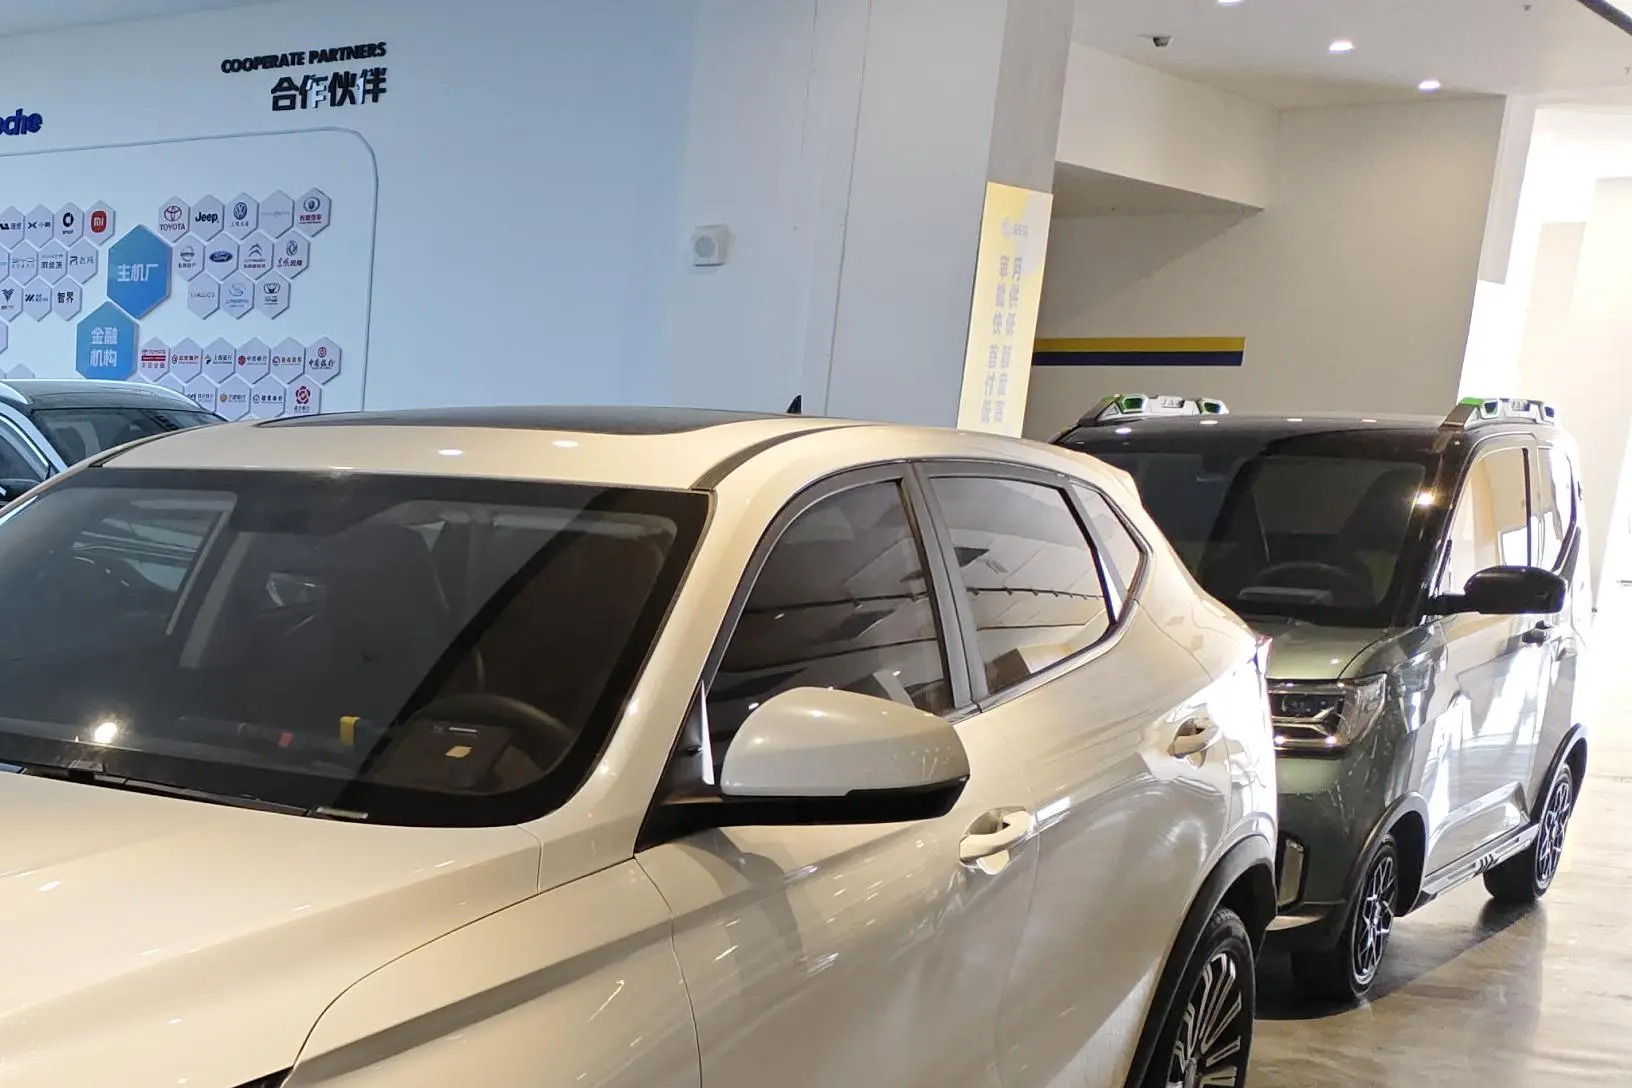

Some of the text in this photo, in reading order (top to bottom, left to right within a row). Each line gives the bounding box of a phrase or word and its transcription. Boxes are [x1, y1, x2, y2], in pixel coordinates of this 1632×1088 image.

[220, 42, 387, 74] COOPERATE PARTNERS
[270, 66, 388, 112] 合作伙伴
[159, 222, 186, 232] TOYOTA
[194, 211, 218, 225] Jeep
[116, 262, 160, 282] 主机厂
[90, 326, 119, 345] 金融
[90, 348, 118, 368] 机构
